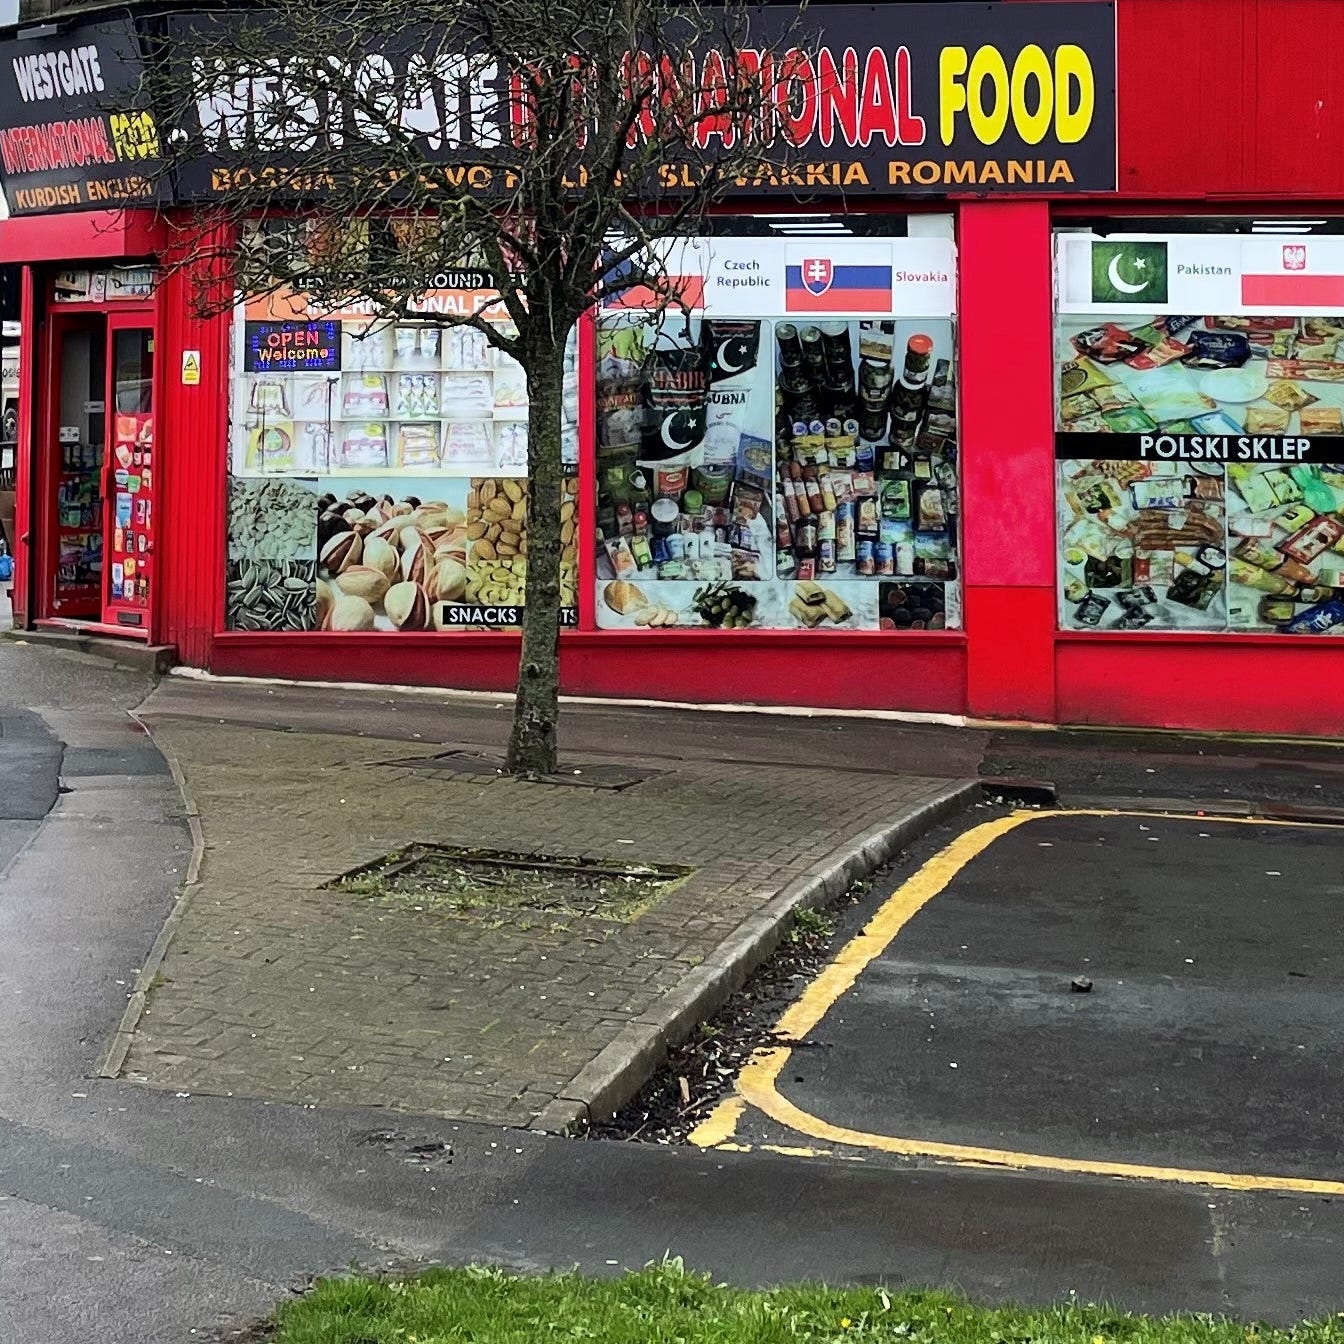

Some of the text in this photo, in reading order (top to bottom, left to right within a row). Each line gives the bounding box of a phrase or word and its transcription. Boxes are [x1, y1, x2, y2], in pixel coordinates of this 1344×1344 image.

[12, 45, 105, 103] WESTGATE
[508, 46, 926, 149] INTRNATIONAL
[939, 44, 1095, 146] FOOD
[109, 111, 160, 162] FOOD
[887, 159, 1075, 187] ROMANIA
[15, 176, 153, 209] KURDISH ENGLISH
[724, 259, 760, 270] Czech
[1177, 264, 1232, 275] Pakistan
[717, 276, 771, 288] Republic
[896, 271, 948, 282] Slovakia
[267, 330, 319, 347] OPEN
[257, 346, 329, 362] Welcome
[1140, 435, 1311, 460] POLSKI SKLEP
[449, 607, 517, 623] SNACKS
